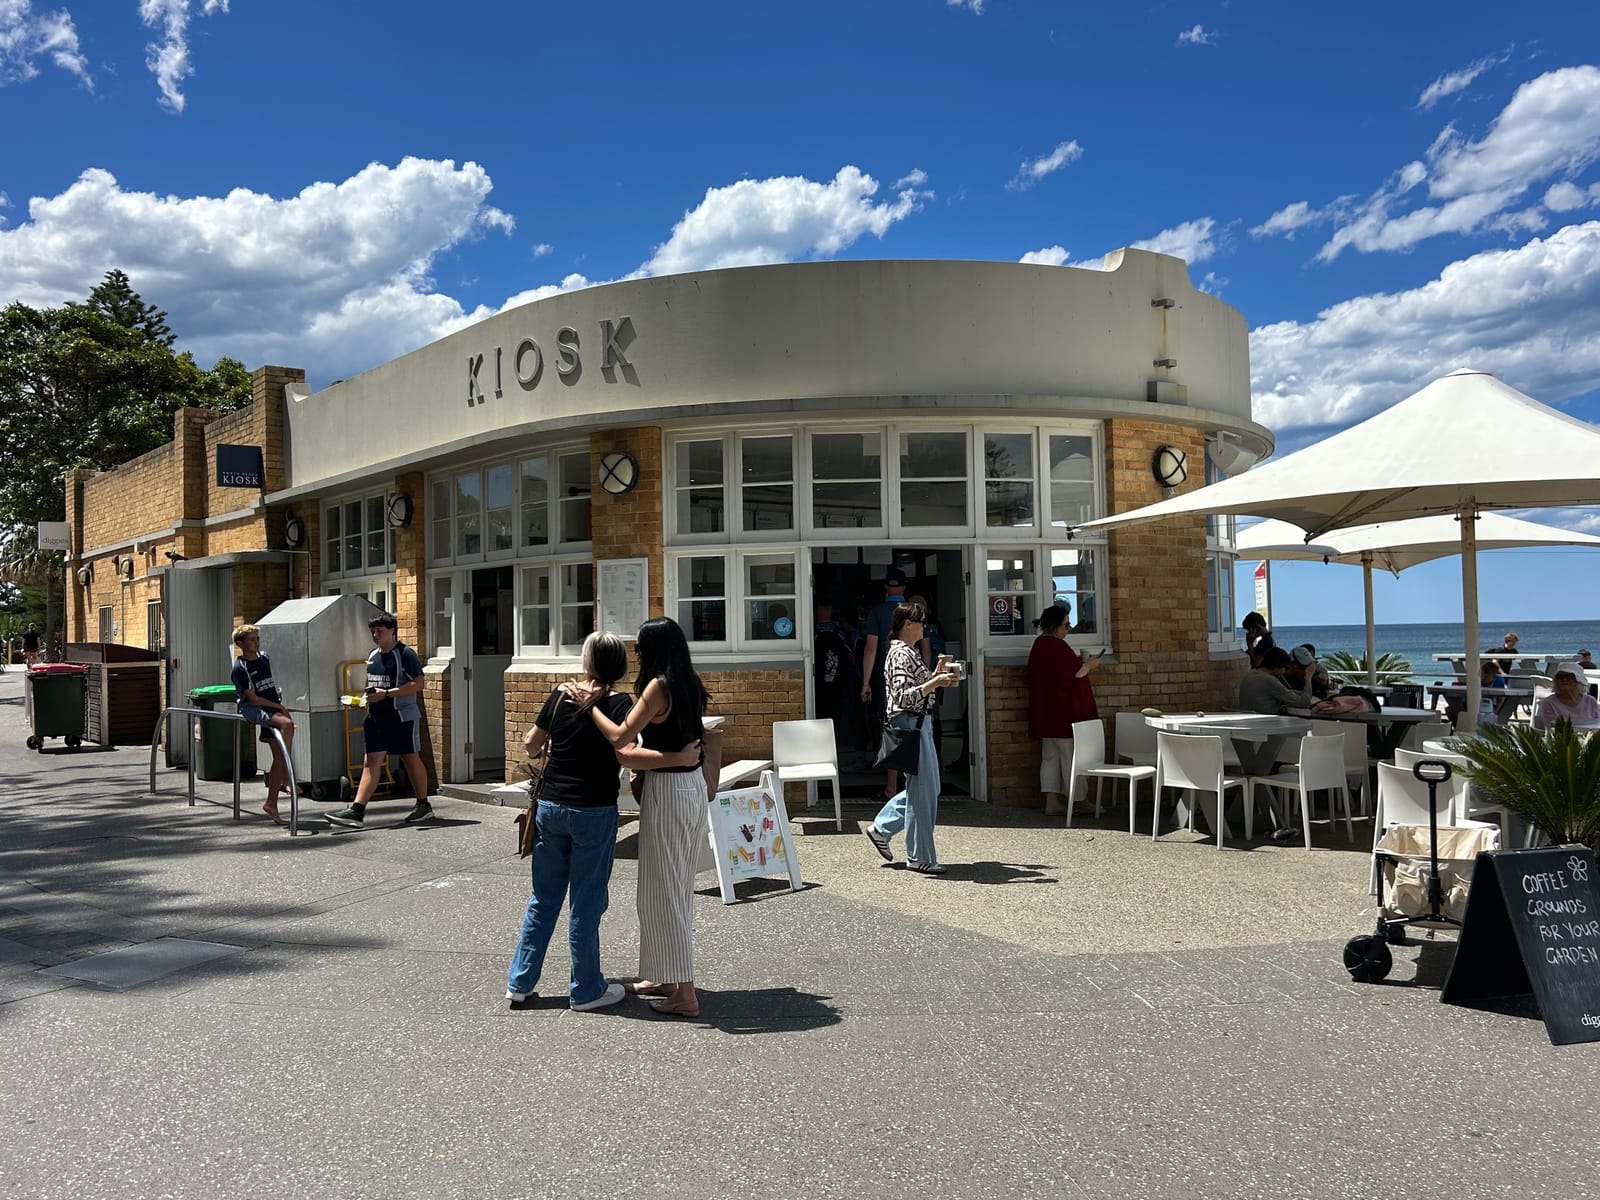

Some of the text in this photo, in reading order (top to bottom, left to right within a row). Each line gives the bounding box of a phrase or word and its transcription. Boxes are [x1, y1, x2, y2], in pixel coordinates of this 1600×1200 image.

[466, 317, 634, 402] KIOSK
[223, 475, 259, 485] KIOSK
[1522, 870, 1568, 894] COFFEE
[1527, 899, 1587, 917] GROUNDS
[1539, 919, 1600, 942] FOR YOUR
[1545, 947, 1599, 966] GARDEN
